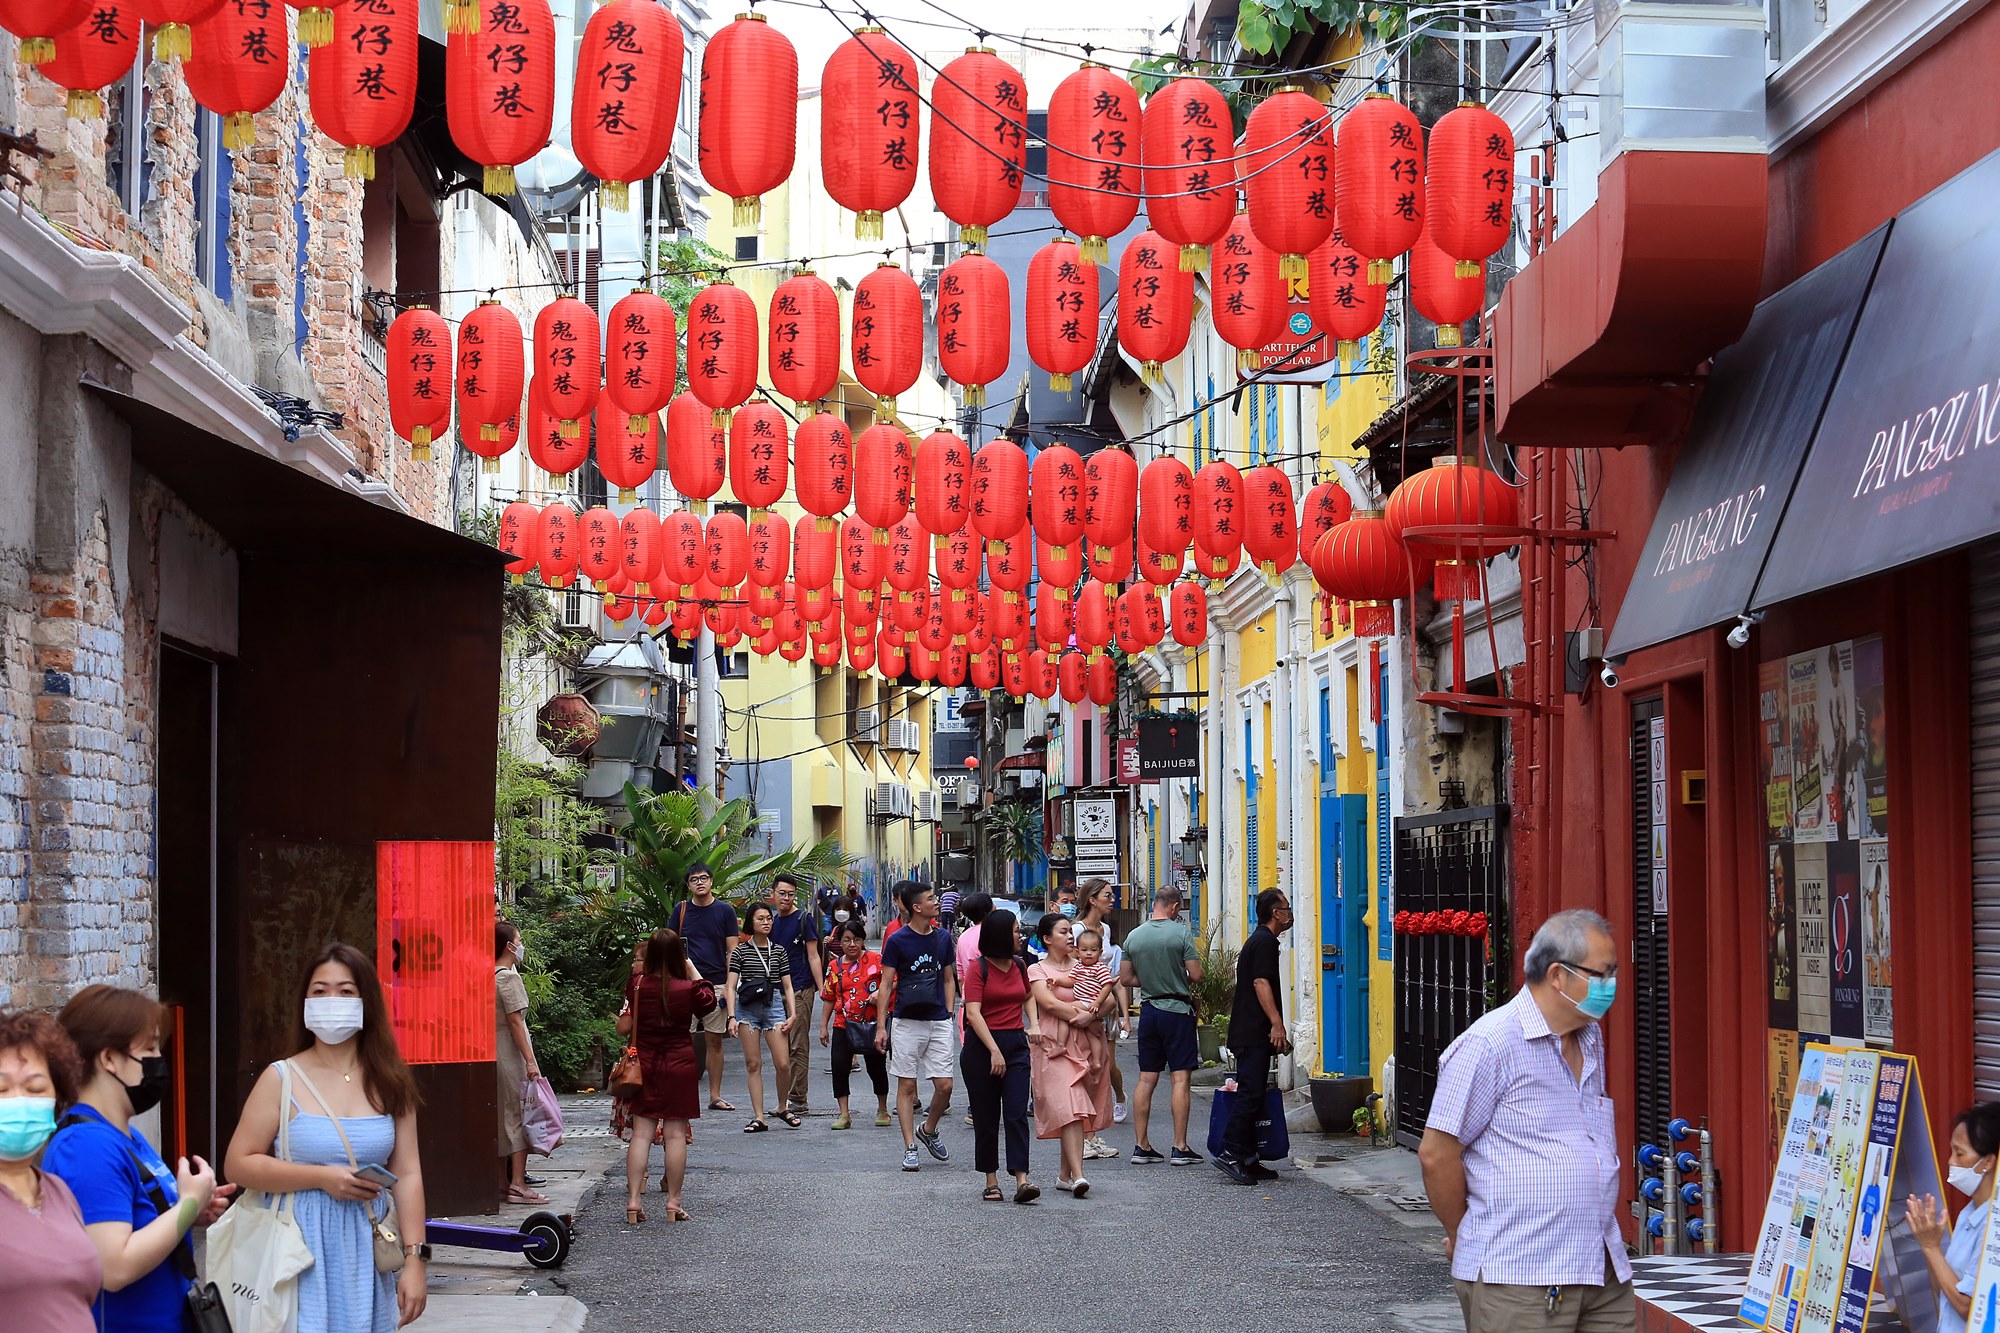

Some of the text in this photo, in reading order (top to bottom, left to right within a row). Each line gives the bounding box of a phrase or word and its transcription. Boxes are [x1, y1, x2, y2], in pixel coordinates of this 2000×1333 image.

[486, 3, 534, 118] 鬼仔巷
[597, 20, 644, 136] 鬼仔巷
[876, 59, 914, 171] 鬼仔巷
[994, 80, 1024, 189] 鬼仔巷
[1091, 90, 1131, 193] 鬼仔巷
[1181, 98, 1222, 202] 鬼仔巷
[1299, 117, 1332, 219] 鬼仔巷
[1390, 121, 1422, 222] 鬼仔巷
[1482, 133, 1511, 228] 鬼仔巷
[1056, 261, 1088, 343] 鬼仔巷
[1132, 247, 1164, 329] 鬼仔巷
[1223, 233, 1255, 317] 鬼仔巷
[699, 303, 728, 378] 鬼仔巷
[775, 294, 804, 371] 鬼仔巷
[855, 289, 881, 367] 鬼仔巷
[941, 275, 967, 354] 鬼仔巷
[1293, 318, 1307, 329] 名
[410, 327, 440, 399] 鬼仔巷
[461, 324, 487, 397] 鬼仔巷
[550, 320, 580, 394] 鬼仔巷
[622, 313, 651, 389] 鬼仔巷
[1260, 343, 1282, 352] ART
[751, 420, 776, 485] 鬼仔巷
[828, 430, 849, 494] 鬼仔巷
[893, 442, 911, 506] 鬼仔巷
[944, 449, 966, 513] 鬼仔巷
[973, 457, 992, 517] 鬼仔巷
[1059, 463, 1081, 525] 鬼仔巷
[1174, 472, 1192, 533] 鬼仔巷
[1214, 476, 1236, 535] 鬼仔巷
[1268, 481, 1289, 539] 鬼仔巷
[550, 515, 568, 560] 鬼仔巷
[590, 520, 609, 565] 鬼仔巷
[624, 522, 642, 567] 鬼仔巷
[681, 523, 700, 568] 鬼仔巷
[708, 527, 726, 573] 鬼仔巷
[753, 523, 771, 571] 鬼仔巷
[847, 527, 867, 575] 鬼仔巷
[893, 525, 912, 575] 鬼仔巷
[912, 586, 926, 618] 仔巷
[965, 585, 976, 621] 仔巷
[1184, 593, 1201, 634] 鬼仔巷
[947, 694, 960, 720] EL
[1760, 689, 1777, 722] GIRLS
[1773, 745, 1791, 777] NIGHT
[1080, 806, 1106, 819] hungry
[1802, 882, 1821, 914] MORE
[1801, 921, 1825, 953] DRAMA
[1807, 959, 1820, 974] INSIDE
